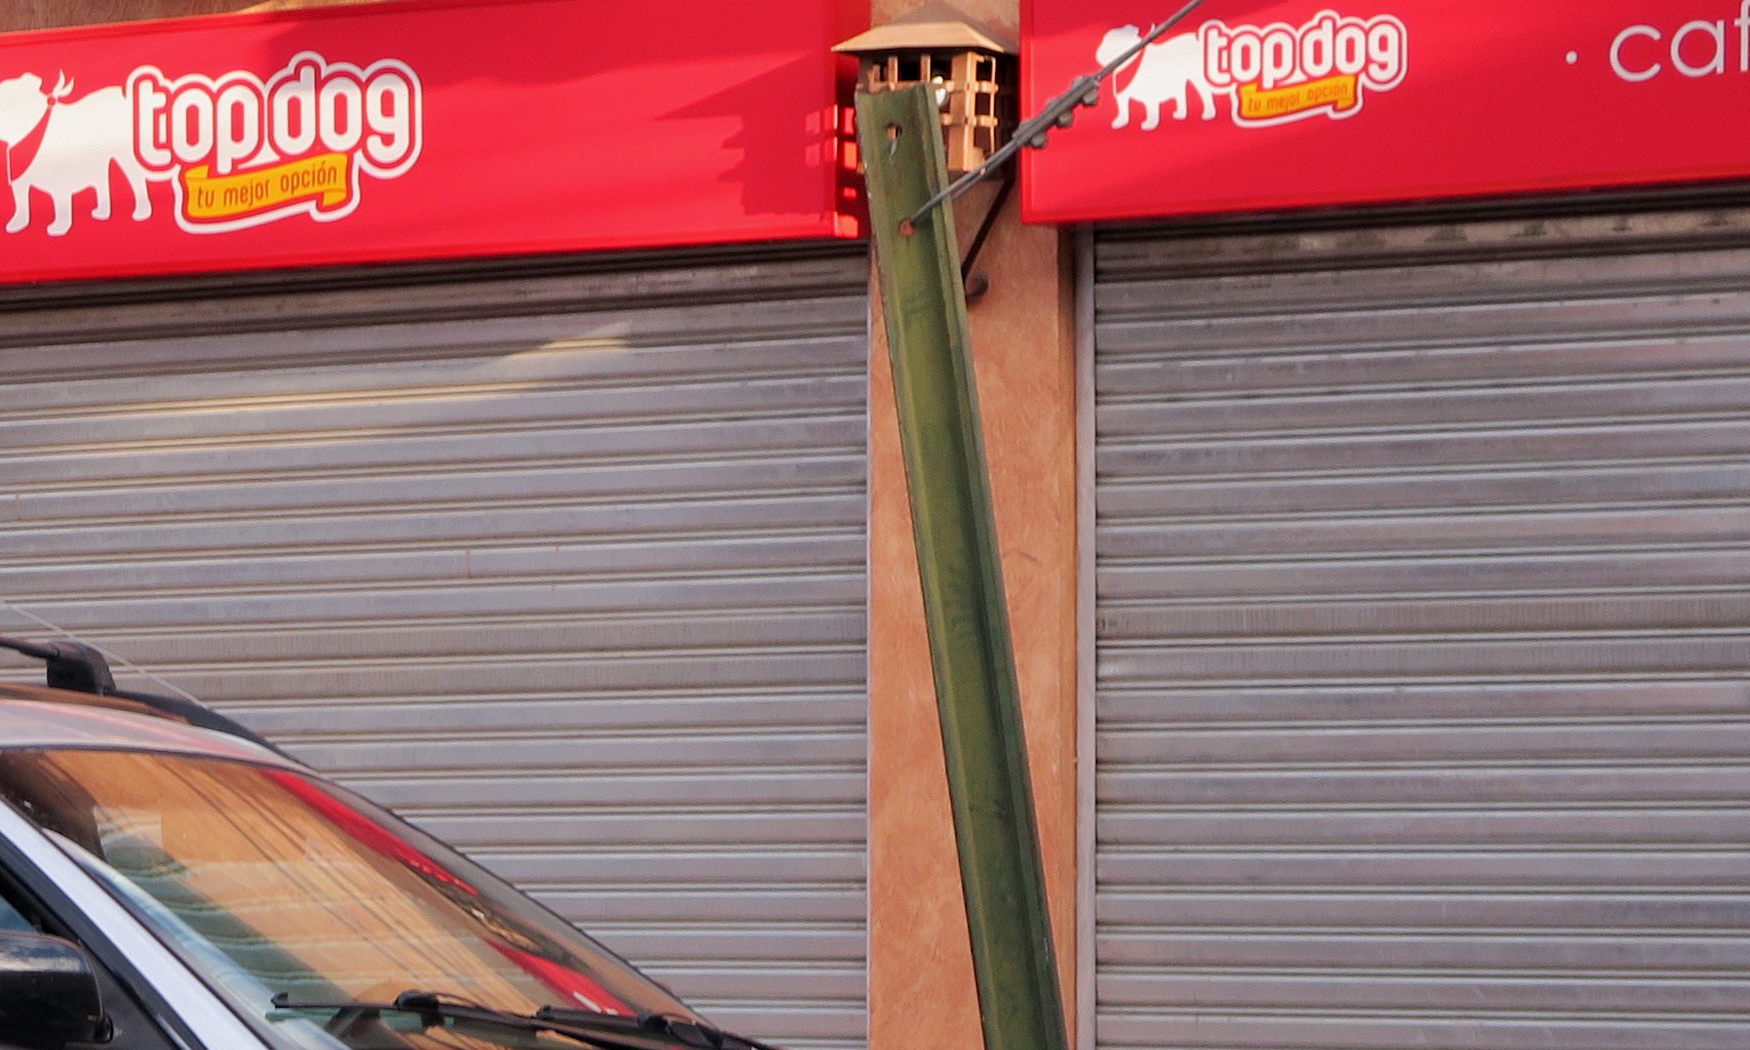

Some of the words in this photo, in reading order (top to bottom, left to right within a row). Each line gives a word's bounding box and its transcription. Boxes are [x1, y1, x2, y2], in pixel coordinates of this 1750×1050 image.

[138, 65, 410, 175] topdog
[197, 185, 215, 208] tu
[223, 179, 270, 207] mejor
[280, 161, 338, 195] opción
